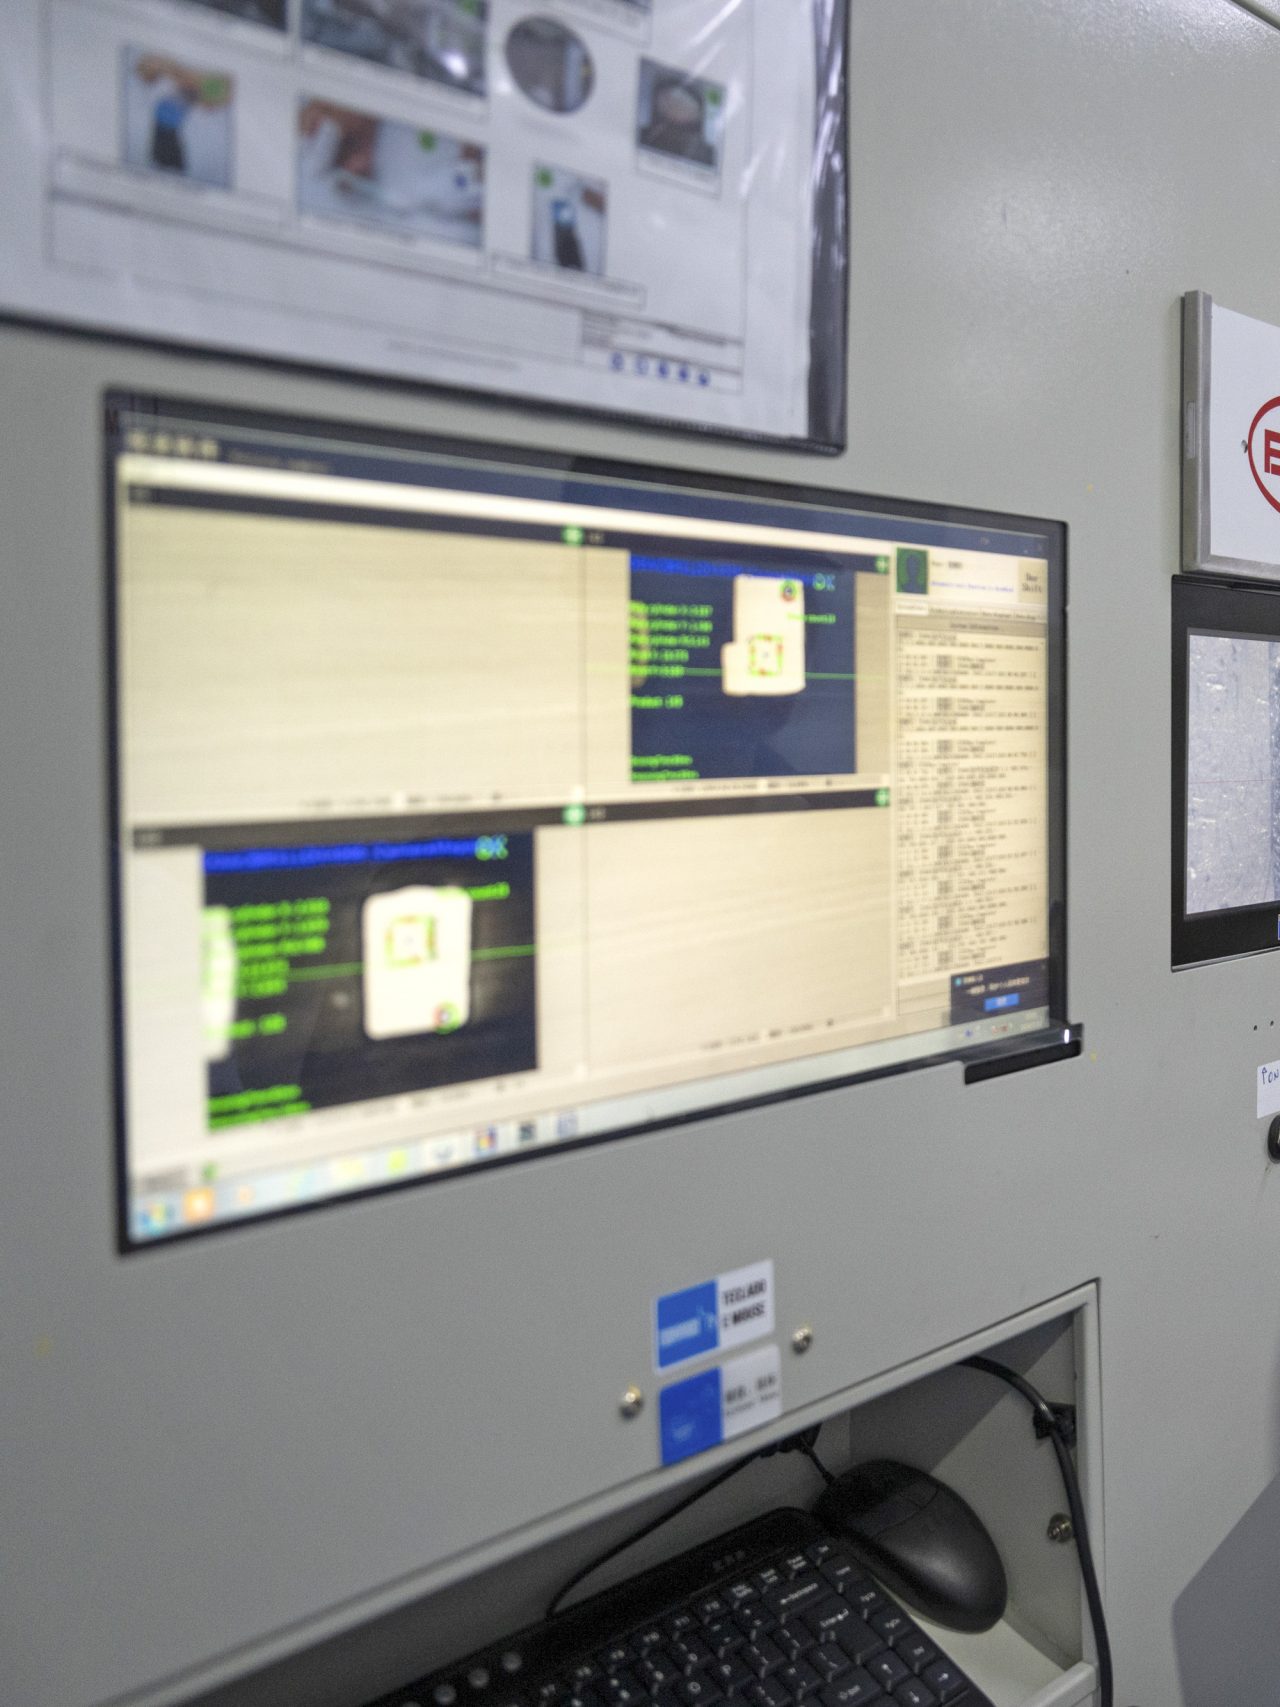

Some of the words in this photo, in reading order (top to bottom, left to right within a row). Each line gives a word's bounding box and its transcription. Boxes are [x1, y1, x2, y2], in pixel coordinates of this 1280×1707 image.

[813, 573, 836, 591] OK
[474, 835, 509, 861] OK
[1268, 1069, 1279, 1083] ON
